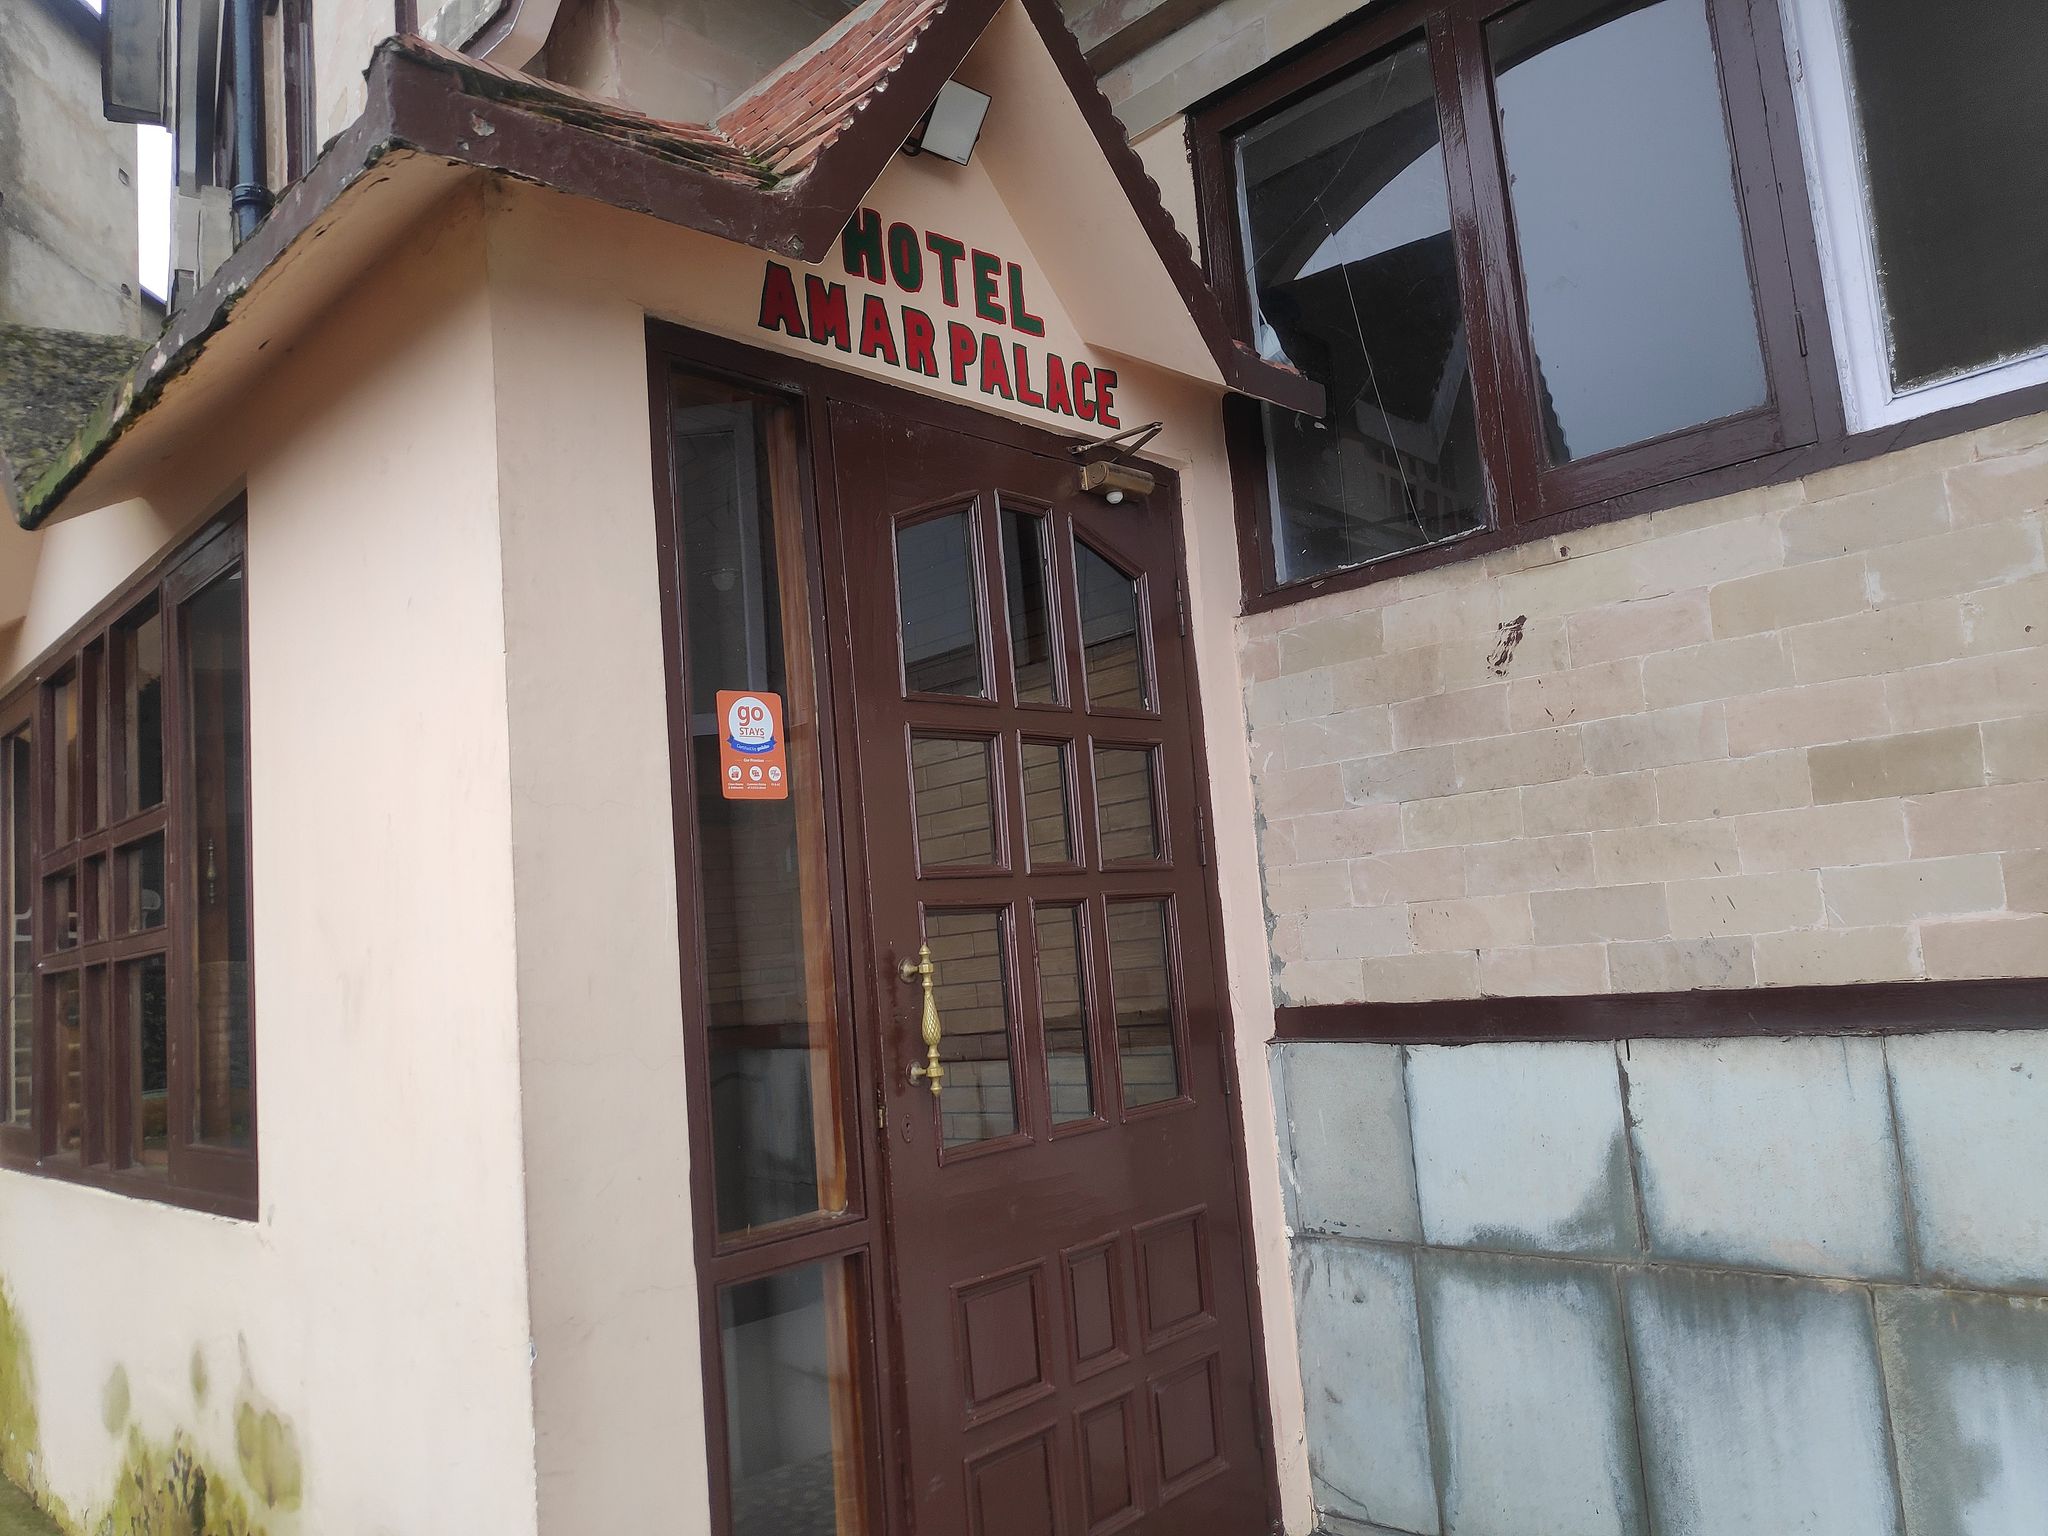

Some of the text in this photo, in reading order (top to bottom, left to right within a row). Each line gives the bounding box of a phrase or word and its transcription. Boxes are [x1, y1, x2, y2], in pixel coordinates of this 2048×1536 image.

[841, 207, 1045, 338] HOTEL
[737, 705, 764, 727] go
[739, 727, 765, 736] STAYS
